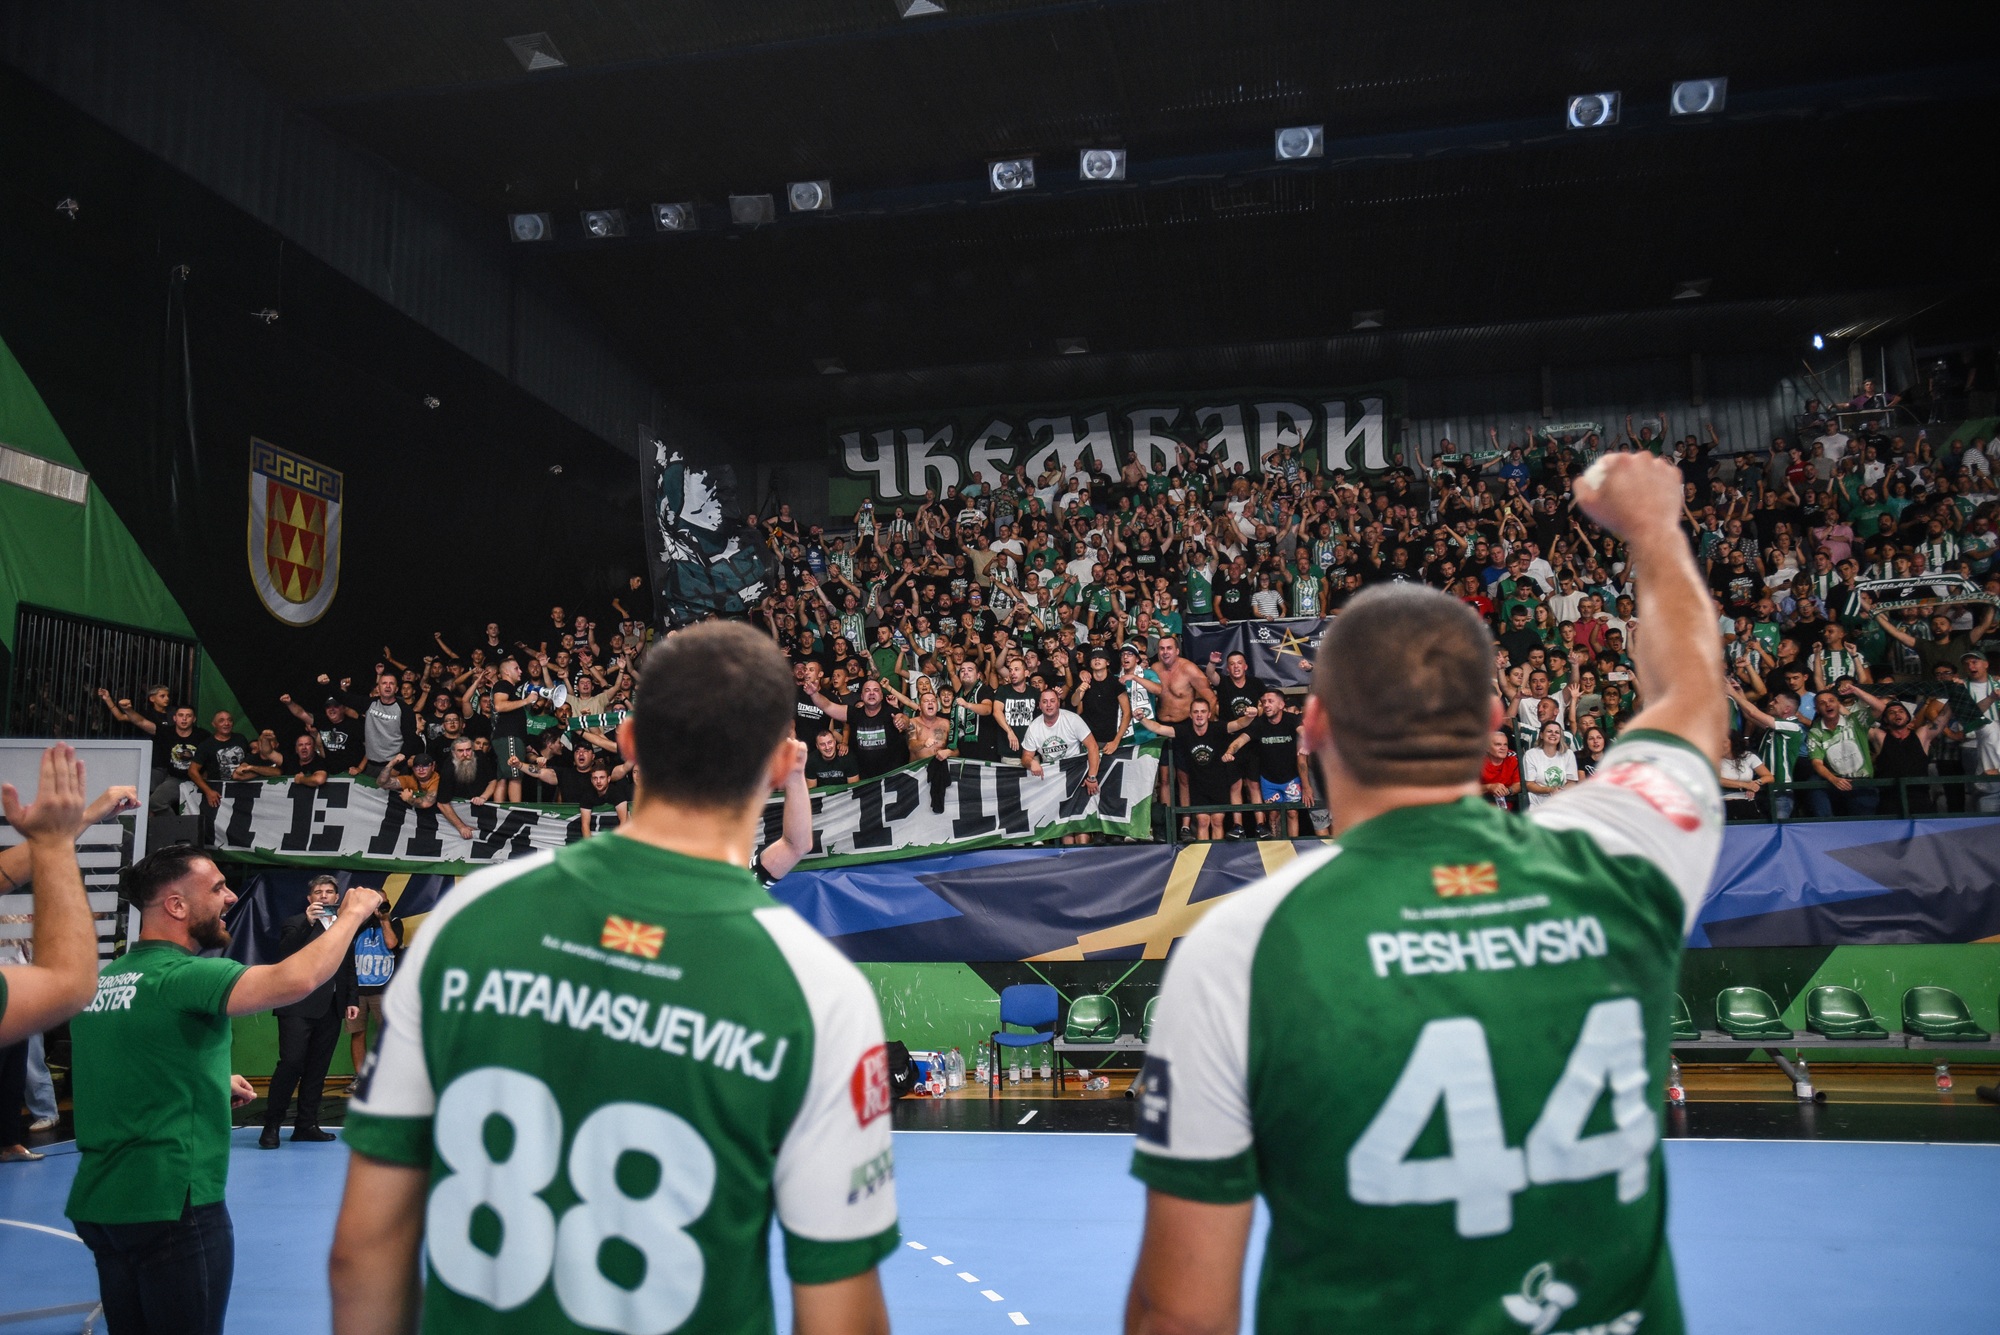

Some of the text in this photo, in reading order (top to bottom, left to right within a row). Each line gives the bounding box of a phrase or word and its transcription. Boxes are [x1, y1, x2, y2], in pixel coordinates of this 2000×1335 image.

[355, 954, 392, 977] HOTO
[1367, 915, 1608, 978] PESHEVSKI
[440, 968, 790, 1083] P. ATANASIJEVIKJ
[1347, 998, 1658, 1238] 44
[426, 1065, 718, 1335] 88
